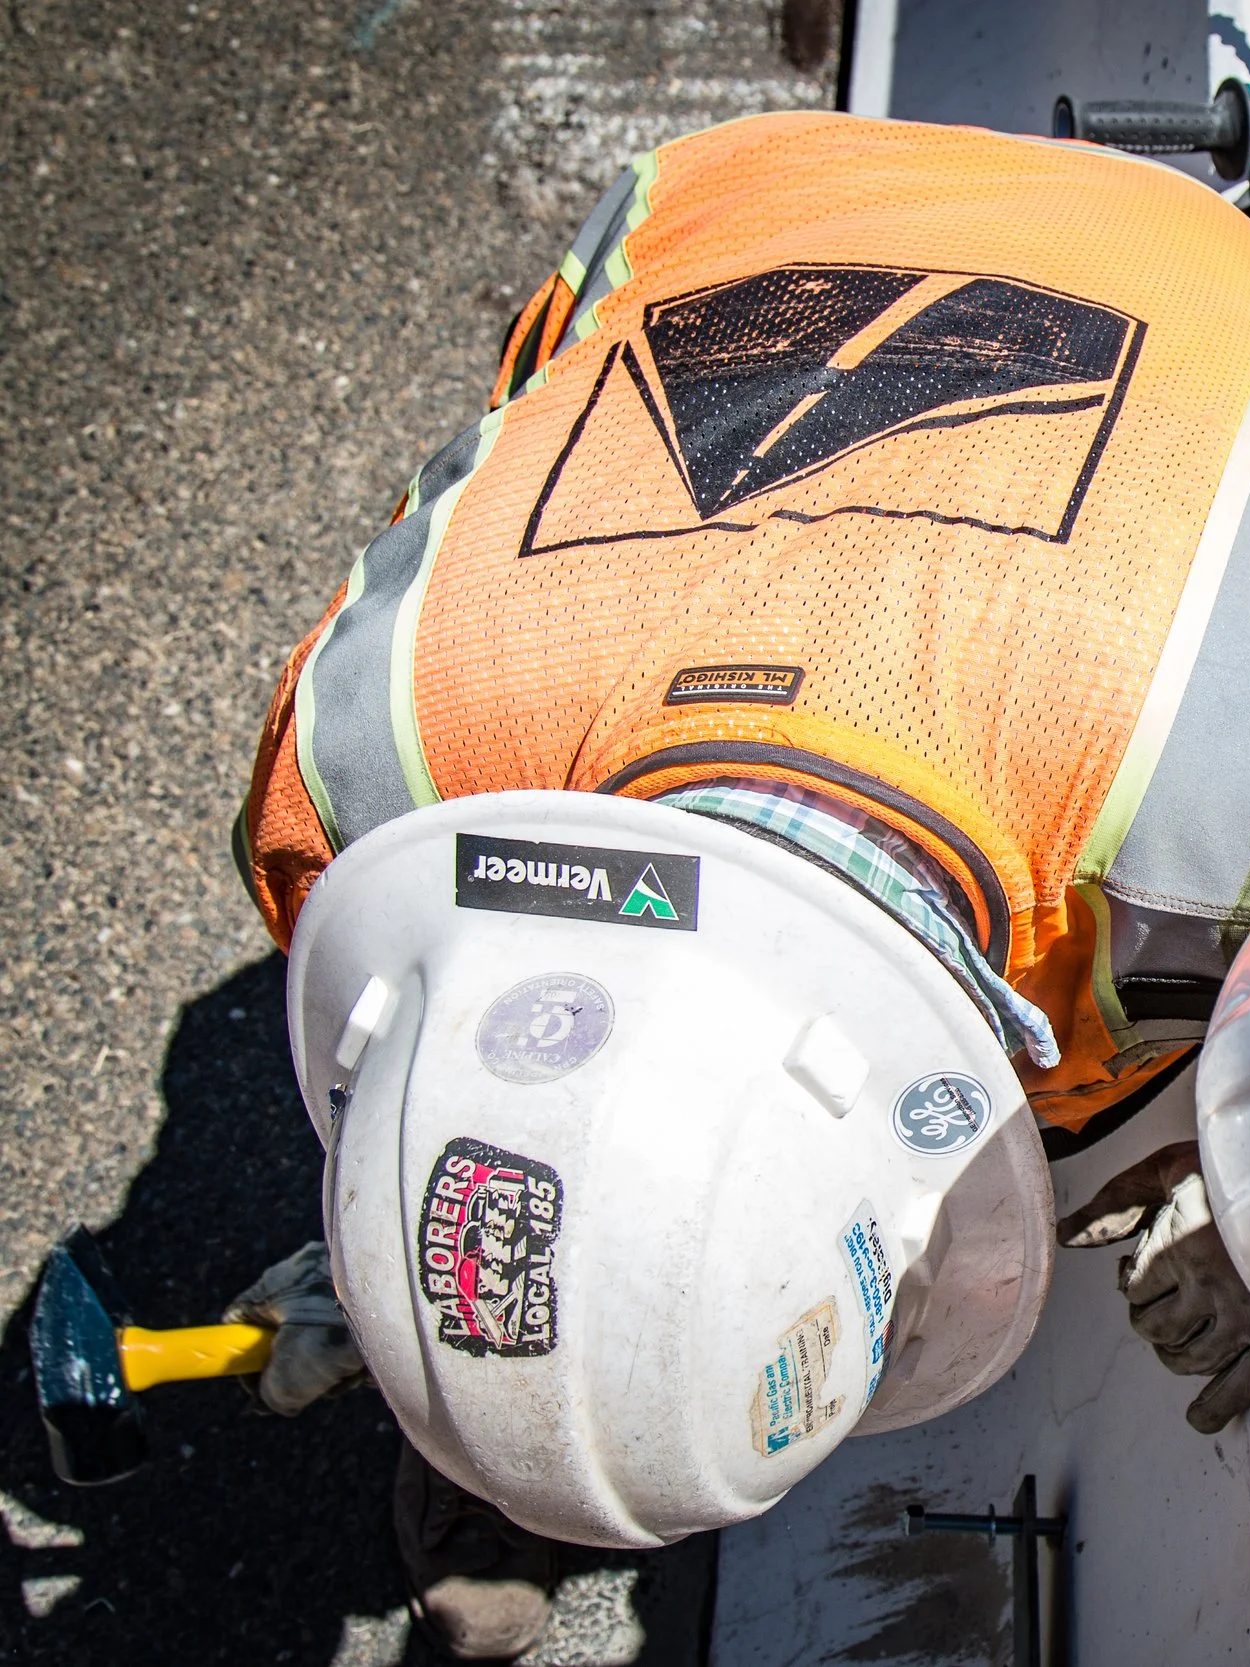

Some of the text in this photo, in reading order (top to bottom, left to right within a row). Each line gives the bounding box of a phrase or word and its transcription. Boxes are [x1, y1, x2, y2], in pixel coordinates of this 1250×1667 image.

[681, 684, 748, 692] ORIGINAL
[683, 672, 788, 684] ML KISHIGO
[474, 855, 612, 902] Vermeer
[504, 978, 605, 1011] SAFETY ORIENTATION
[503, 1049, 561, 1063] CALPINE
[425, 1155, 476, 1337] LABORERS
[522, 1176, 557, 1343] LOCAL 185
[854, 1259, 864, 1278] YOU
[823, 1326, 831, 1348] Date
[766, 1377, 778, 1399] Gas
[781, 1389, 793, 1421] Electric
